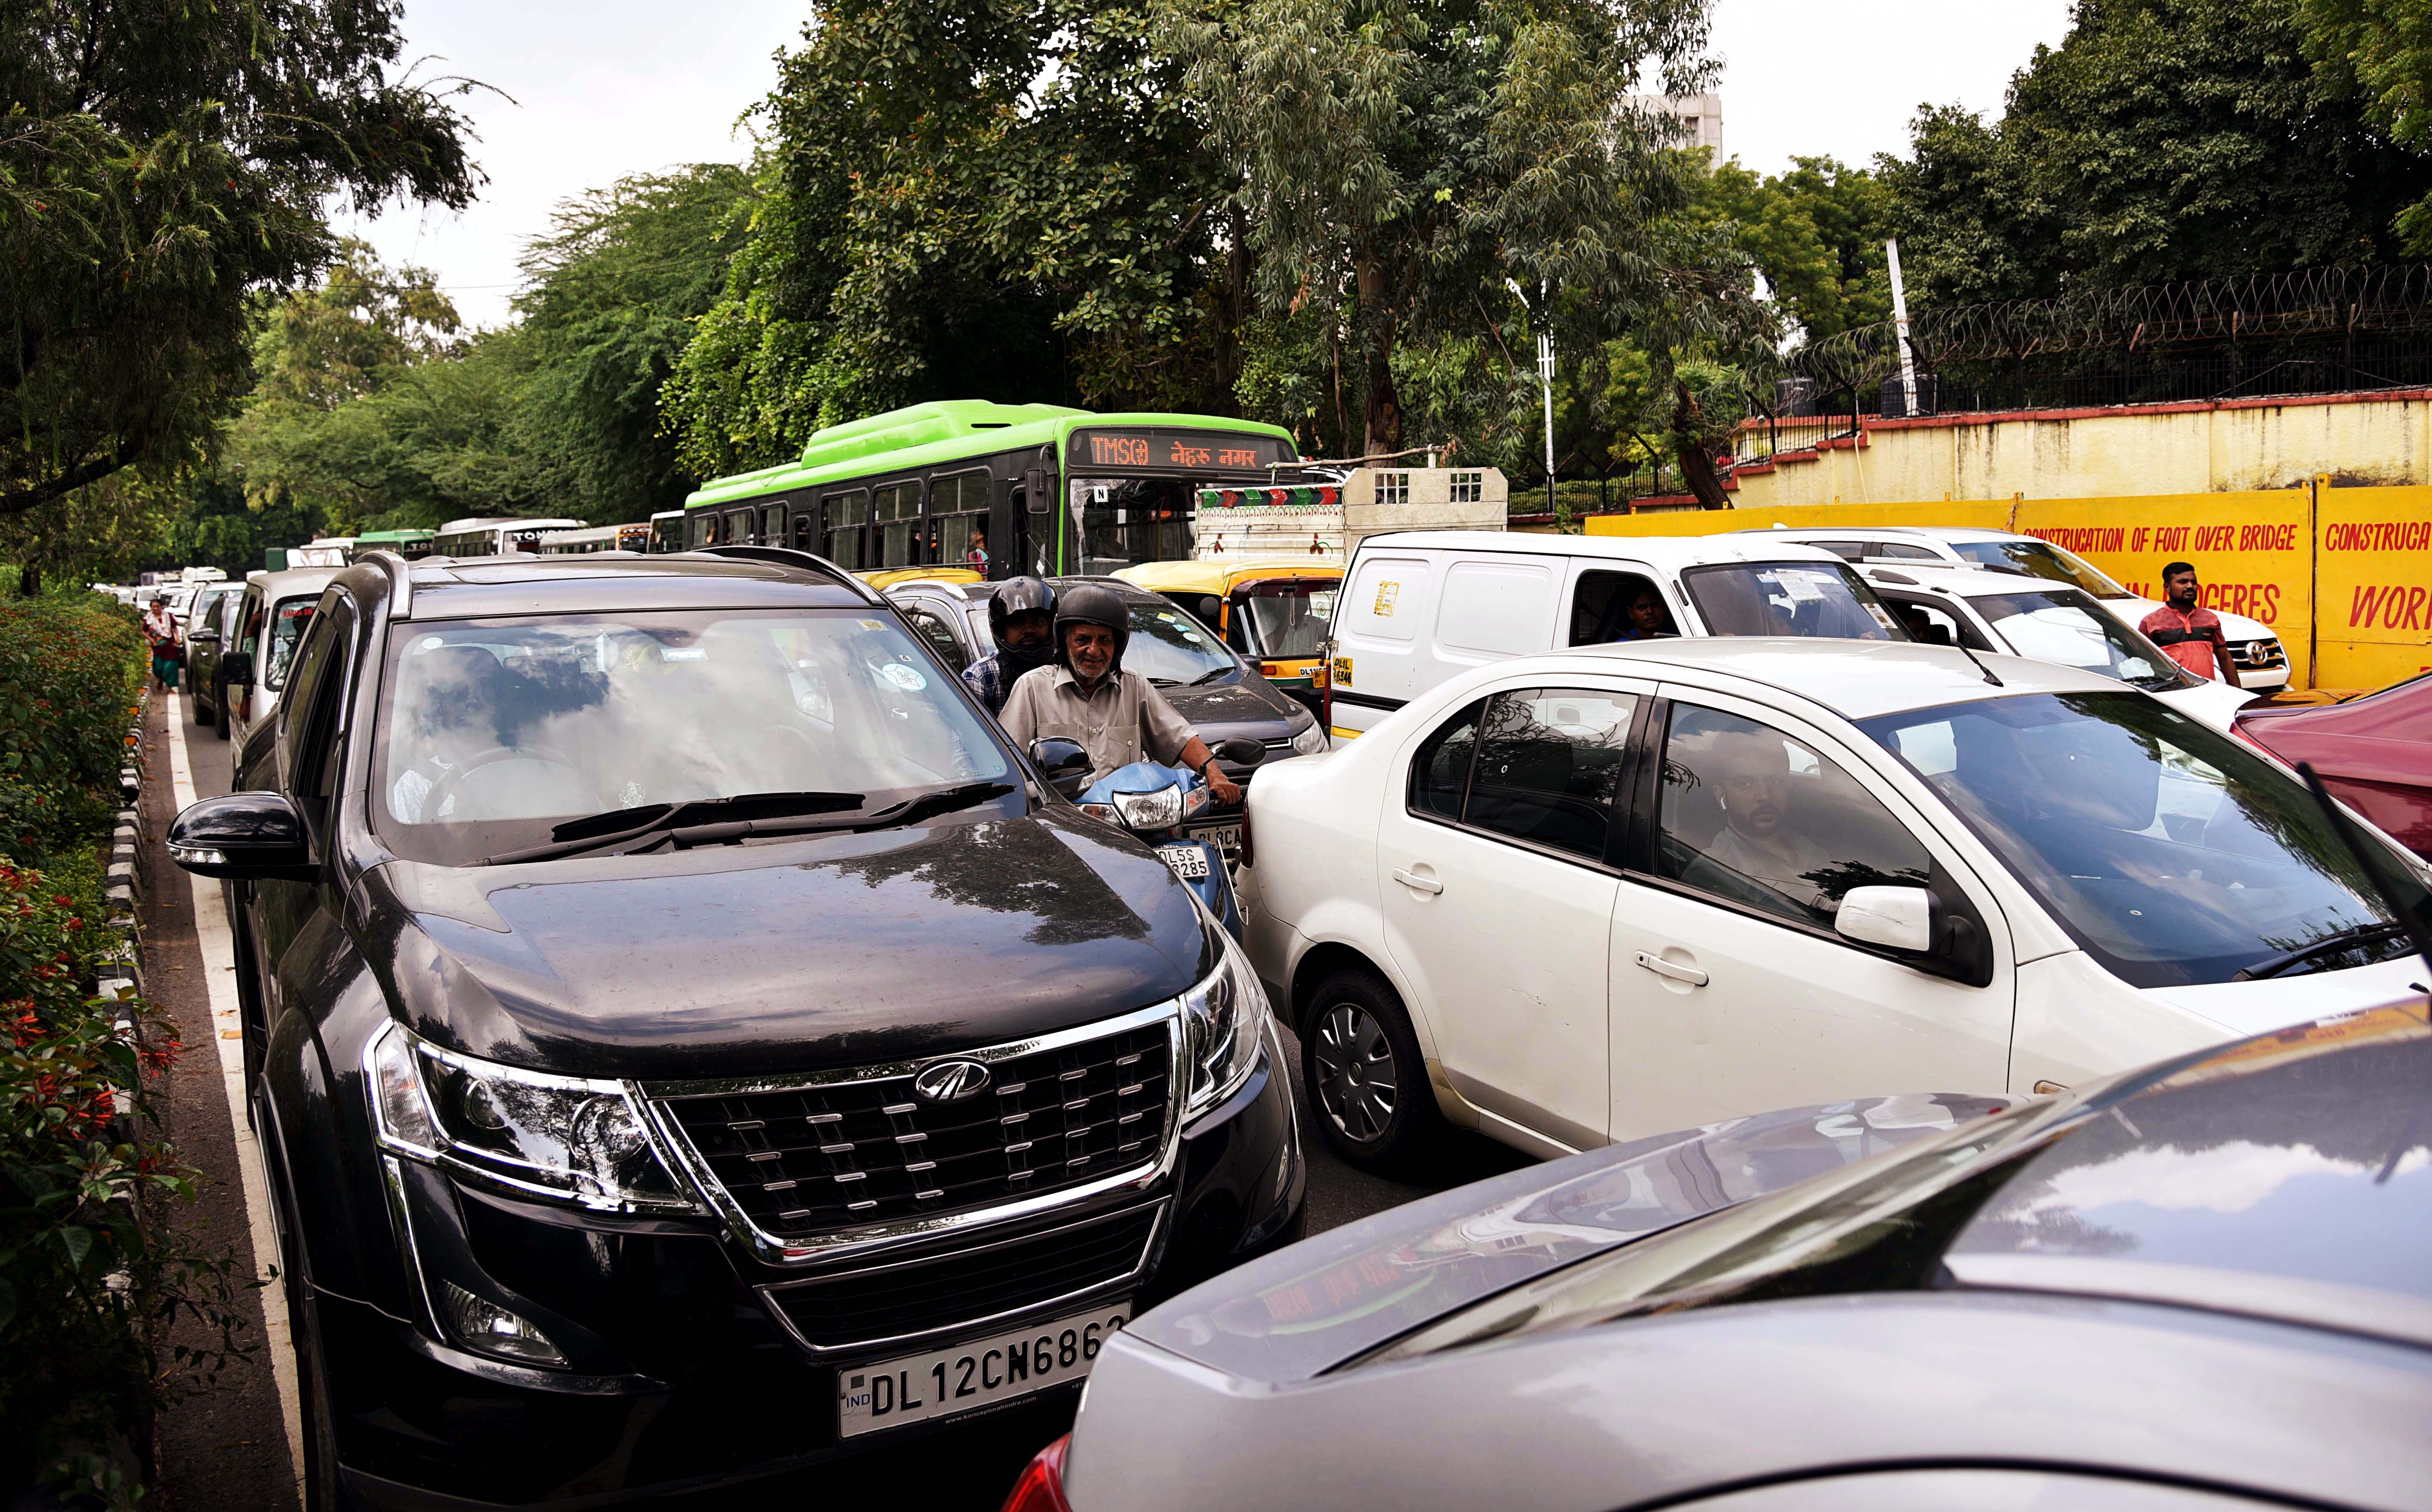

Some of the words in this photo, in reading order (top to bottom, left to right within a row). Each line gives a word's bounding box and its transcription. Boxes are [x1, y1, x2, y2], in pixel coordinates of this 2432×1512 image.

[1219, 449, 1256, 468] नगर
[1098, 489, 1104, 499] N
[2131, 527, 2150, 553] OF
[2153, 527, 2191, 552] FOOT
[2195, 526, 2234, 552] OVER
[2240, 524, 2298, 551] BRIDGE
[2325, 521, 2432, 552] CONSTRUCA
[847, 1394, 870, 1408] IND
[945, 1396, 1037, 1424] www.konceptmahindra.com
